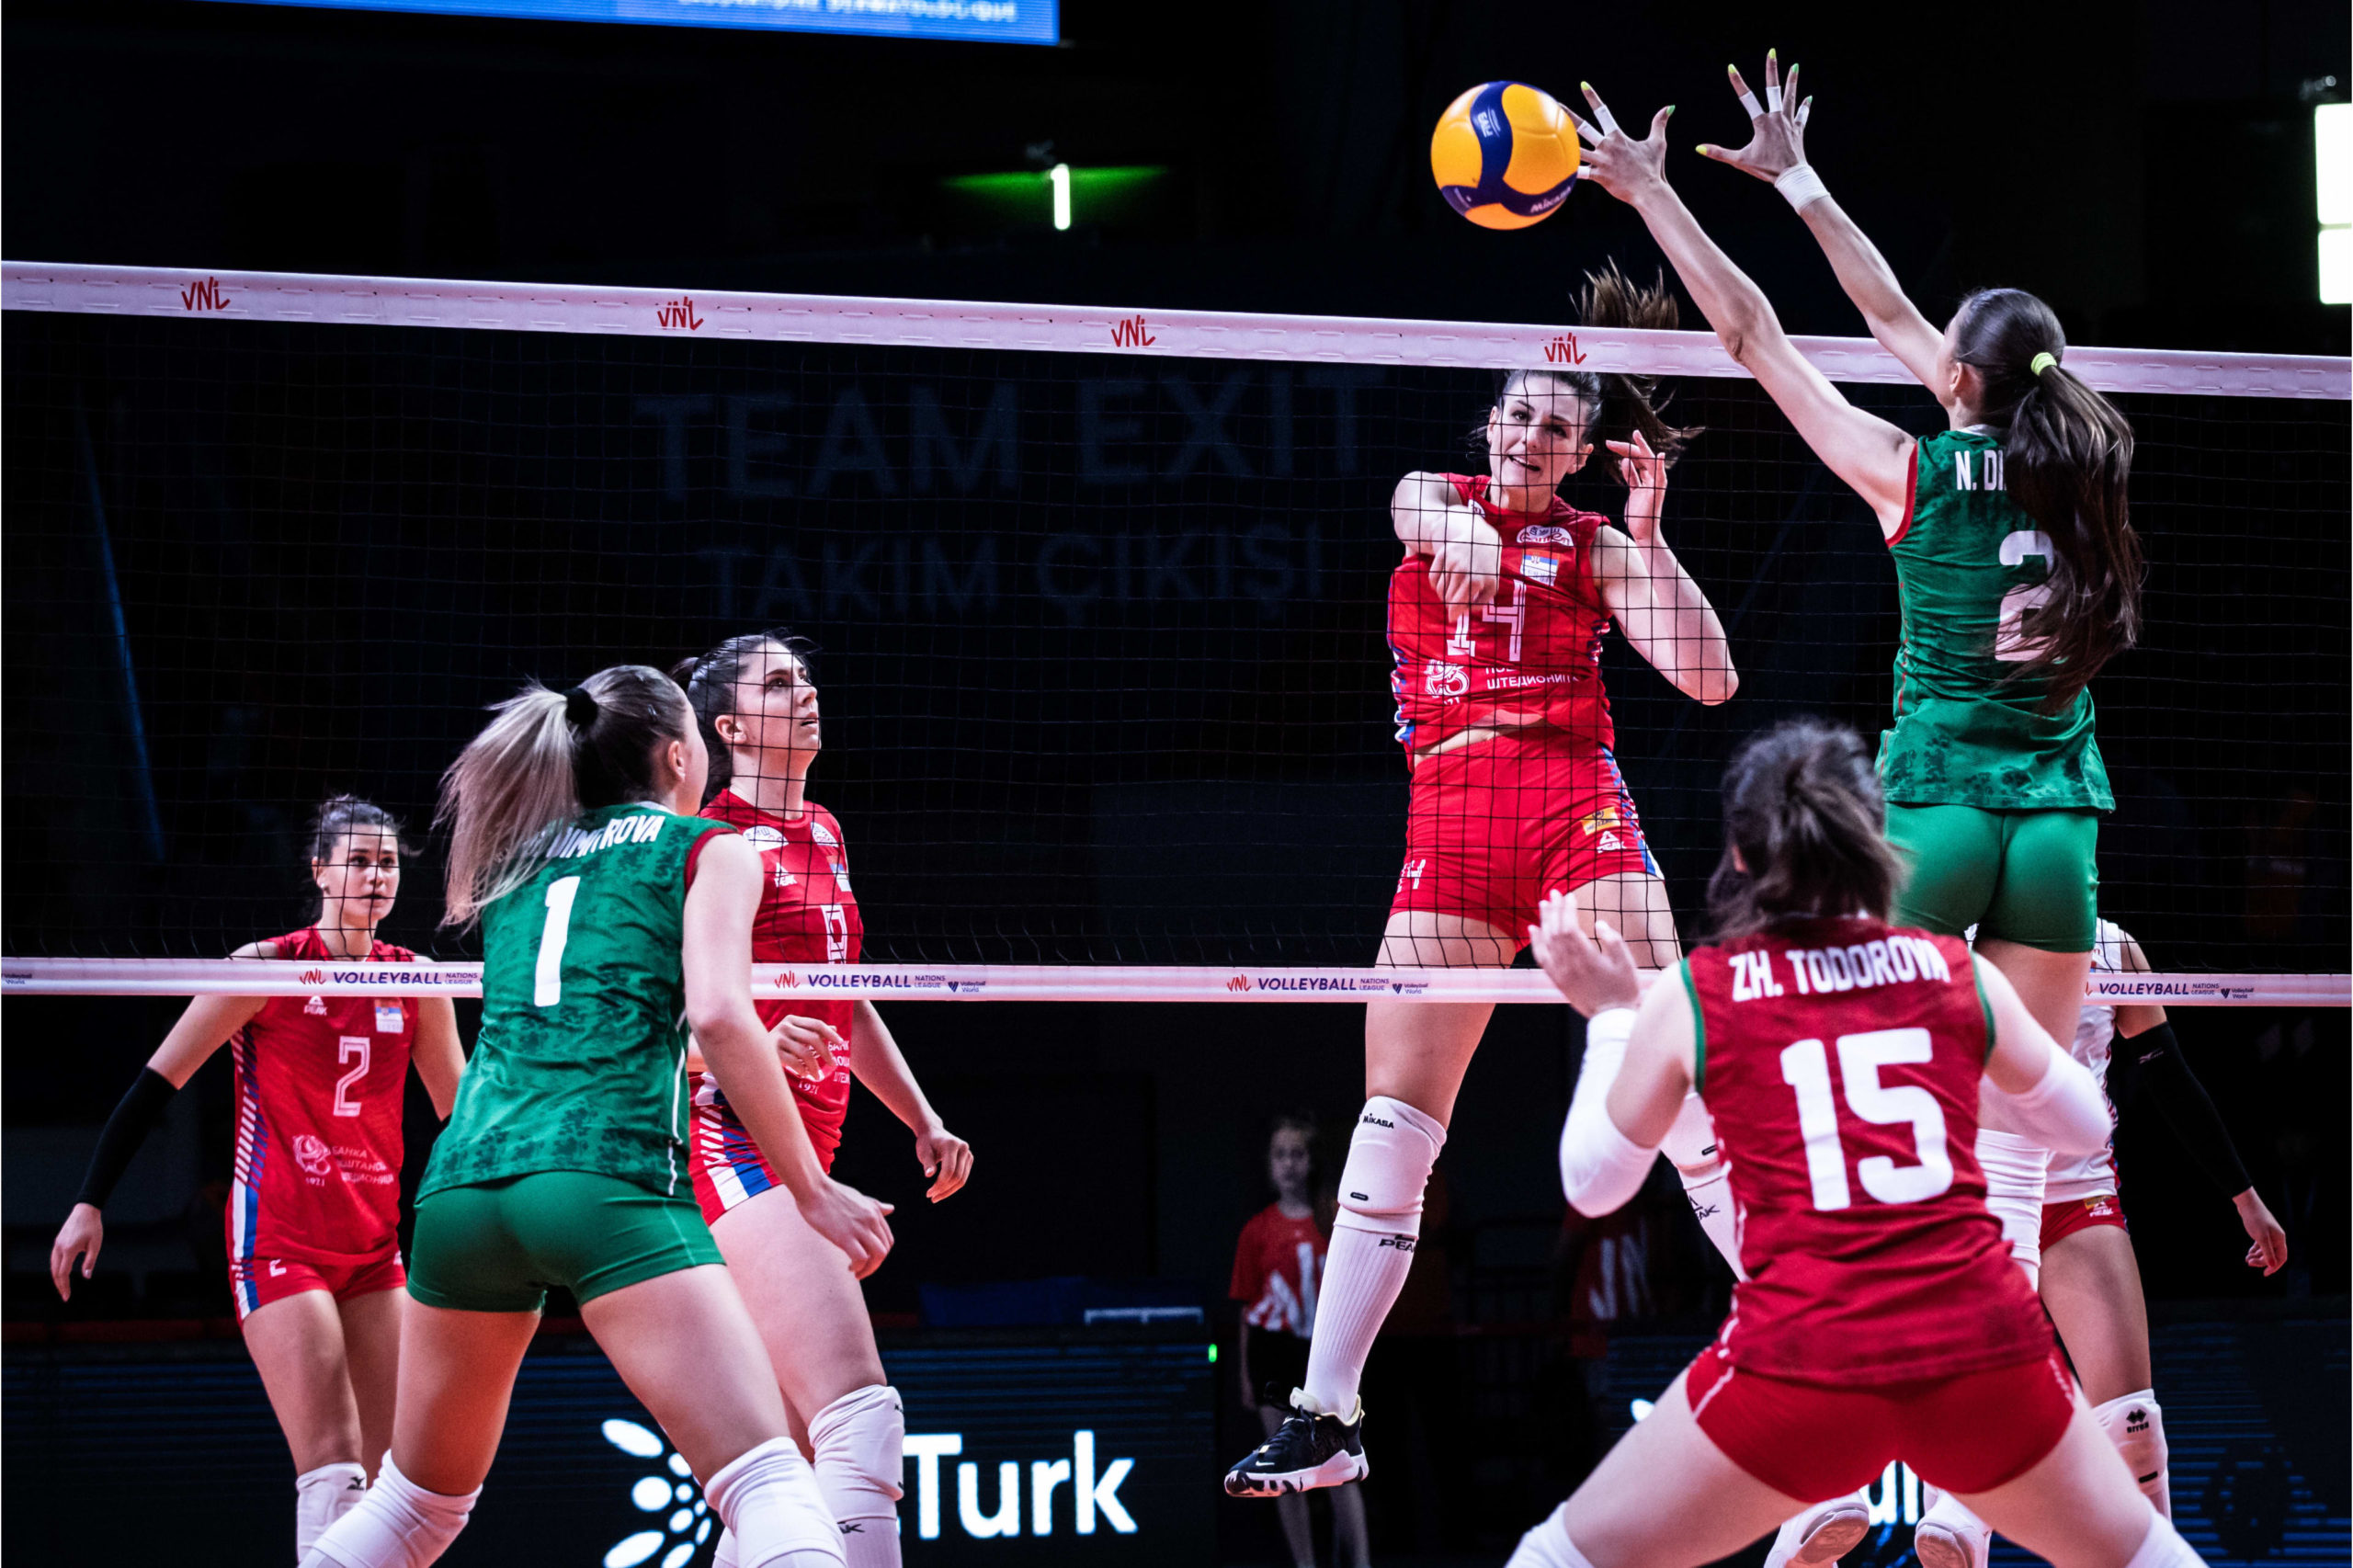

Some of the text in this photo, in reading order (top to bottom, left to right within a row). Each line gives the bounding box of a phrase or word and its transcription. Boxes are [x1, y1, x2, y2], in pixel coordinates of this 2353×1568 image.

[634, 367, 1388, 502] TEAM EXIT
[1984, 449, 2007, 491] DI
[697, 537, 998, 619] TAKIM
[1995, 530, 2059, 662] 2
[333, 971, 442, 984] VOLLEYBALL
[534, 876, 581, 1007] 1
[1728, 935, 1951, 1002] ZH. TODOROVA
[807, 974, 912, 988] VOLLEYBALL
[1257, 977, 1358, 991] VOLLEYBALL
[2099, 983, 2189, 995] VOLLEYBALL
[333, 1036, 370, 1117] 2
[1779, 1026, 1954, 1211] 15
[1379, 1237, 1416, 1254] PEA
[896, 1429, 1139, 1540] Turk
